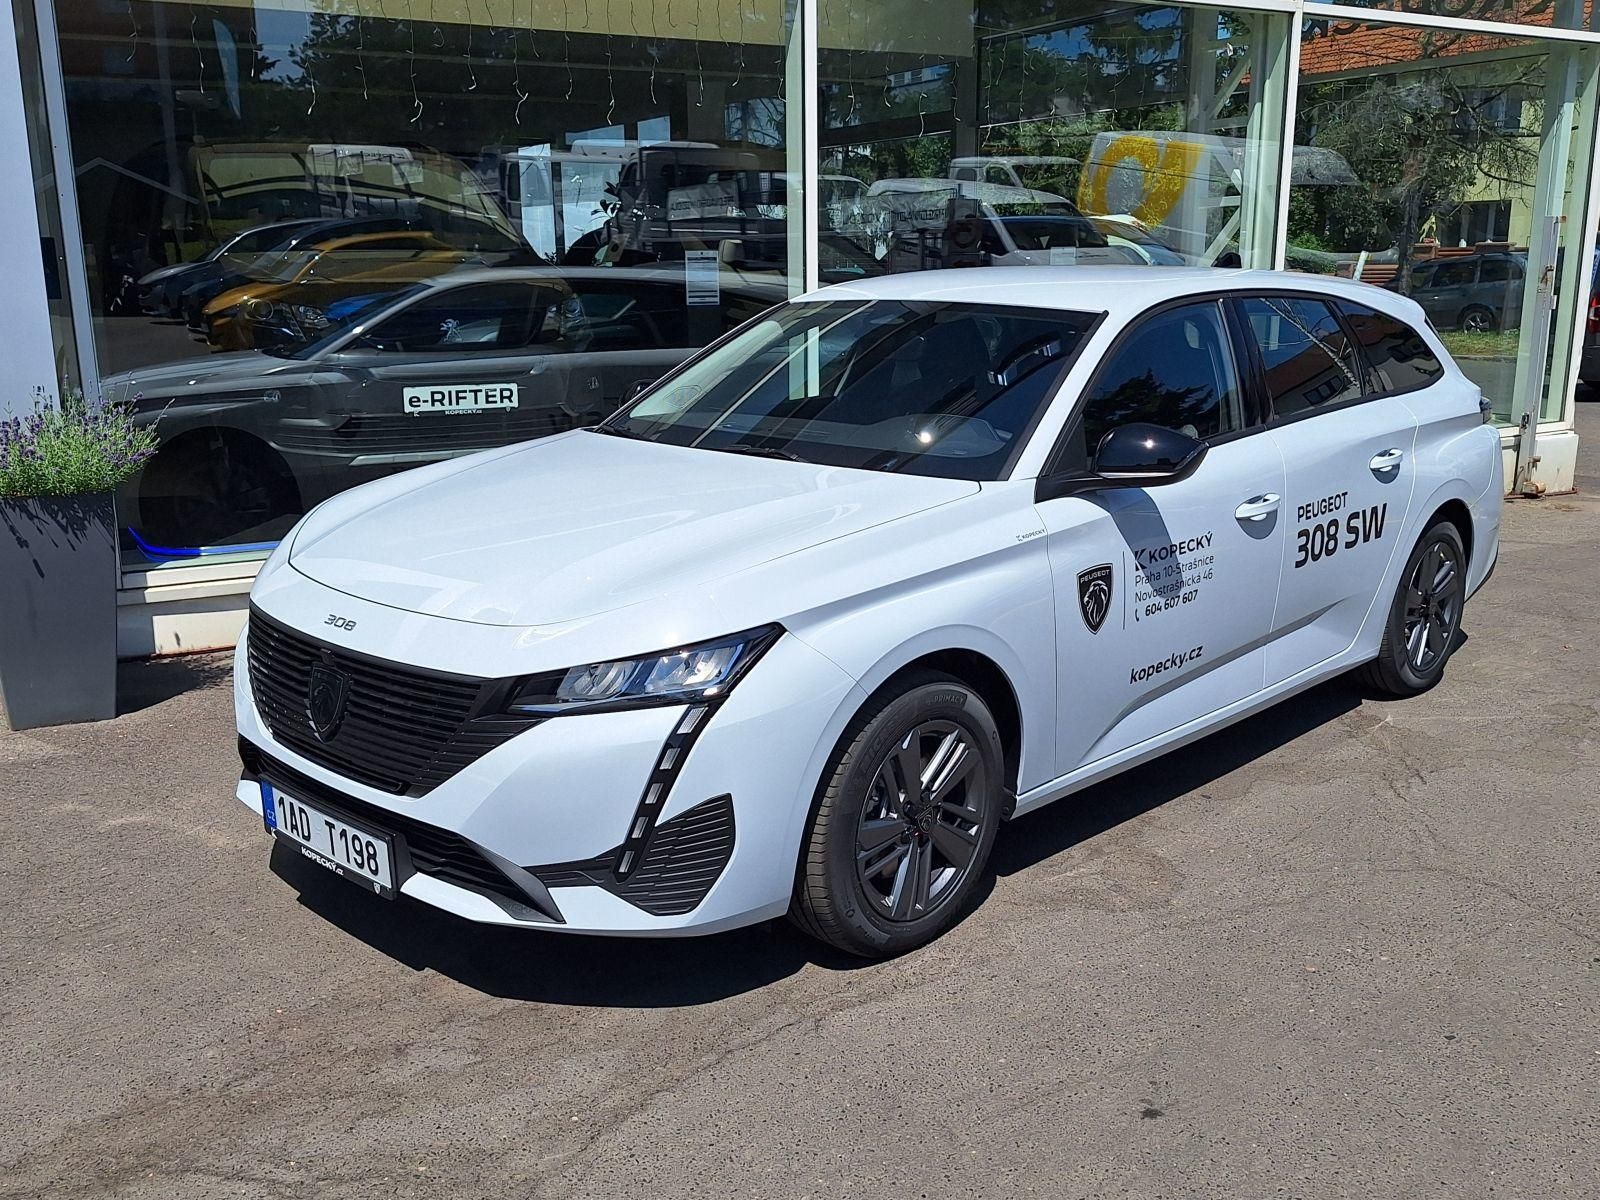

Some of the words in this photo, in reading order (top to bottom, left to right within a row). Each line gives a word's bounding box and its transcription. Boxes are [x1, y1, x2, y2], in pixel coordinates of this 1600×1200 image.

[408, 387, 514, 408] e-RIFTER
[1297, 491, 1348, 523] PEUGEOT
[1149, 531, 1213, 564] KOPECKÝ
[1294, 518, 1340, 569] 308
[1344, 502, 1387, 549] SW
[1080, 568, 1111, 583] PEUGEOT
[1135, 572, 1161, 588] Praha
[1164, 554, 1215, 578] 10-Strašnice
[1135, 574, 1202, 603] Novostrašnická
[1203, 567, 1213, 581] 46
[1145, 603, 1163, 617] 604
[1164, 596, 1181, 611] 607
[1182, 588, 1199, 604] 607
[324, 614, 357, 631] 308
[1129, 645, 1204, 684] kopecky.cz
[278, 796, 312, 842] 1AD
[324, 819, 379, 877] T198
